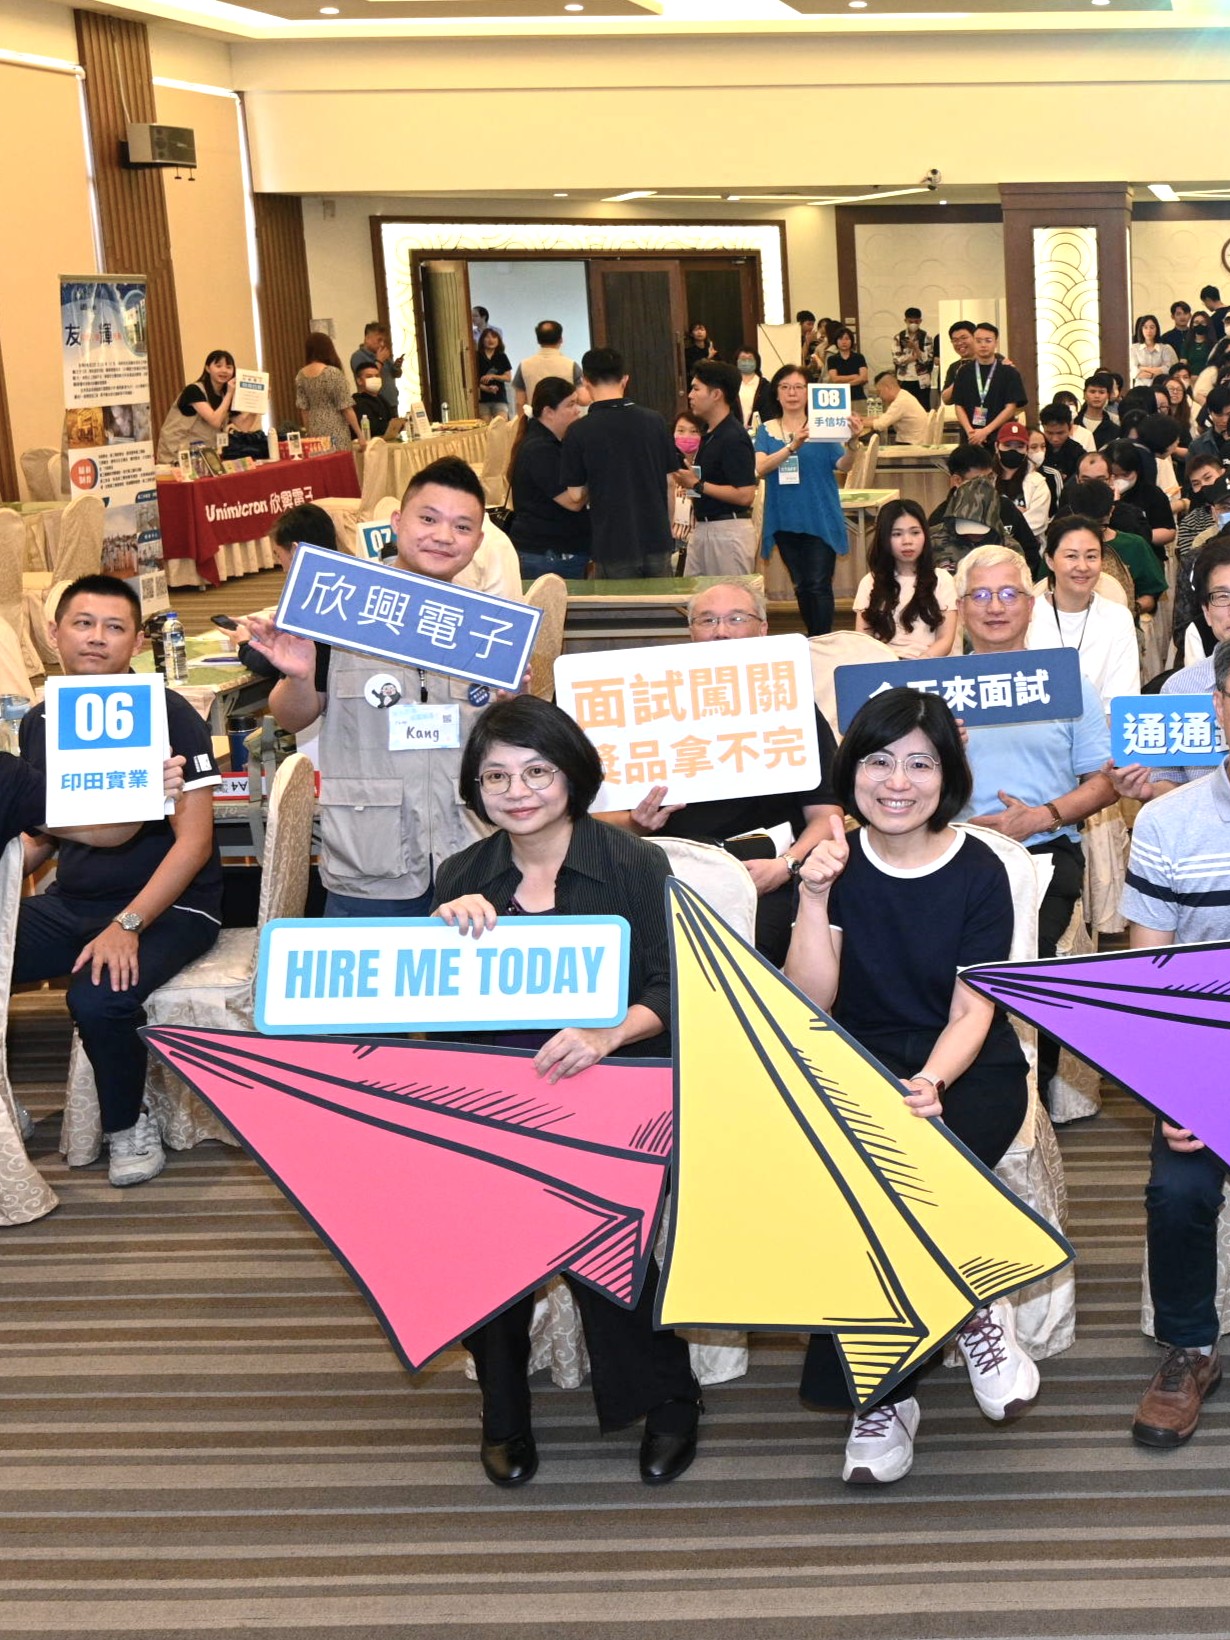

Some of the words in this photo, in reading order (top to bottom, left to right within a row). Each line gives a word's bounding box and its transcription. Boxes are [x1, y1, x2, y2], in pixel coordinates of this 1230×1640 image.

[818, 389, 840, 407] 08
[814, 417, 846, 427] 手信坊
[205, 499, 268, 522] Unimicron
[370, 529, 391, 552] 07
[301, 571, 514, 659] 欣興電子
[571, 660, 798, 730] 面試闖關
[75, 692, 134, 741] 06
[407, 726, 439, 742] Kang
[61, 769, 149, 791] 印田實業
[231, 781, 248, 791] A4
[284, 950, 380, 999] HIRE
[394, 948, 460, 996] ME
[476, 946, 606, 995] TODAY
